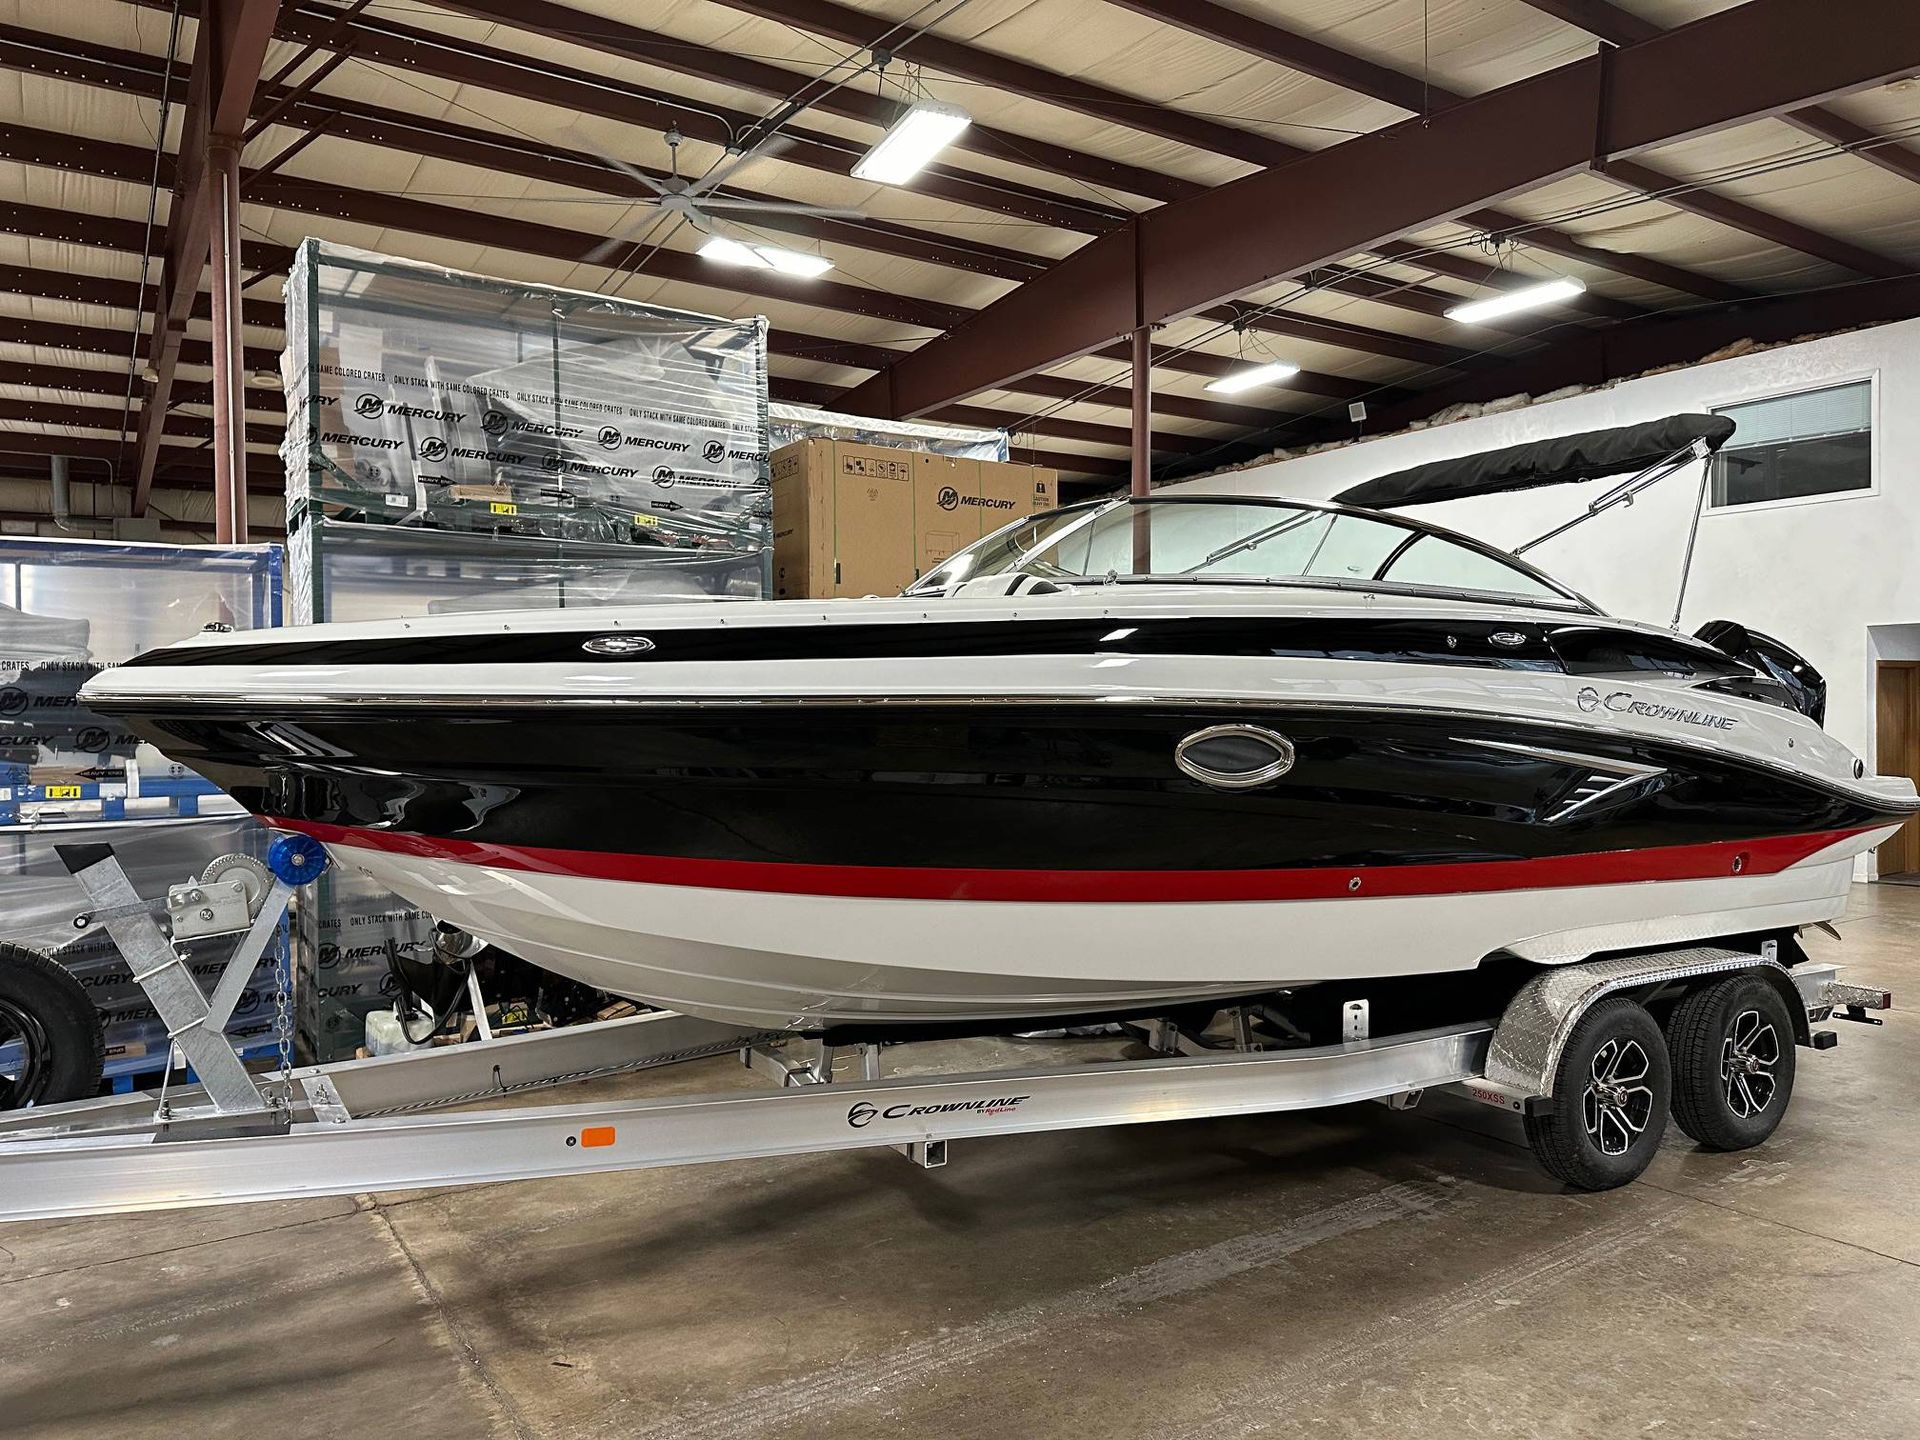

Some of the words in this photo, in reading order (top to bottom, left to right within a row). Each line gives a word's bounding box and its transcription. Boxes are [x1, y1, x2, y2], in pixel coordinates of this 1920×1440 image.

[316, 364, 333, 376] AME
[334, 367, 362, 379] COLORED
[363, 371, 386, 382] CRATES
[410, 377, 428, 388] STACK
[446, 382, 461, 392] SAME
[462, 384, 488, 396] COLORED
[489, 388, 510, 399] CRATES
[517, 391, 531, 402] ONLY
[532, 394, 549, 405] STACK
[604, 404, 623, 415] CRATES
[388, 404, 467, 423] MERCURY
[643, 410, 659, 421] STACK
[511, 420, 584, 438] MERCURY
[321, 432, 404, 450] MERCURY
[624, 436, 691, 453] MERCURY
[451, 447, 526, 465] MERCURY
[570, 461, 639, 478] MERCURY
[960, 495, 1016, 510] MERCURY
[1, 661, 30, 671] CRATES
[40, 661, 59, 671] ONLY
[62, 661, 86, 671] STACK
[1603, 692, 1739, 731] CROWNLINE
[0, 735, 54, 746] CURY
[350, 915, 366, 926] ONLY
[367, 914, 386, 925] STACK
[81, 973, 132, 988] CURY
[318, 983, 363, 998] CURY
[1471, 1088, 1505, 1105] 250XSS
[882, 1095, 1031, 1120] CROWNLINE
